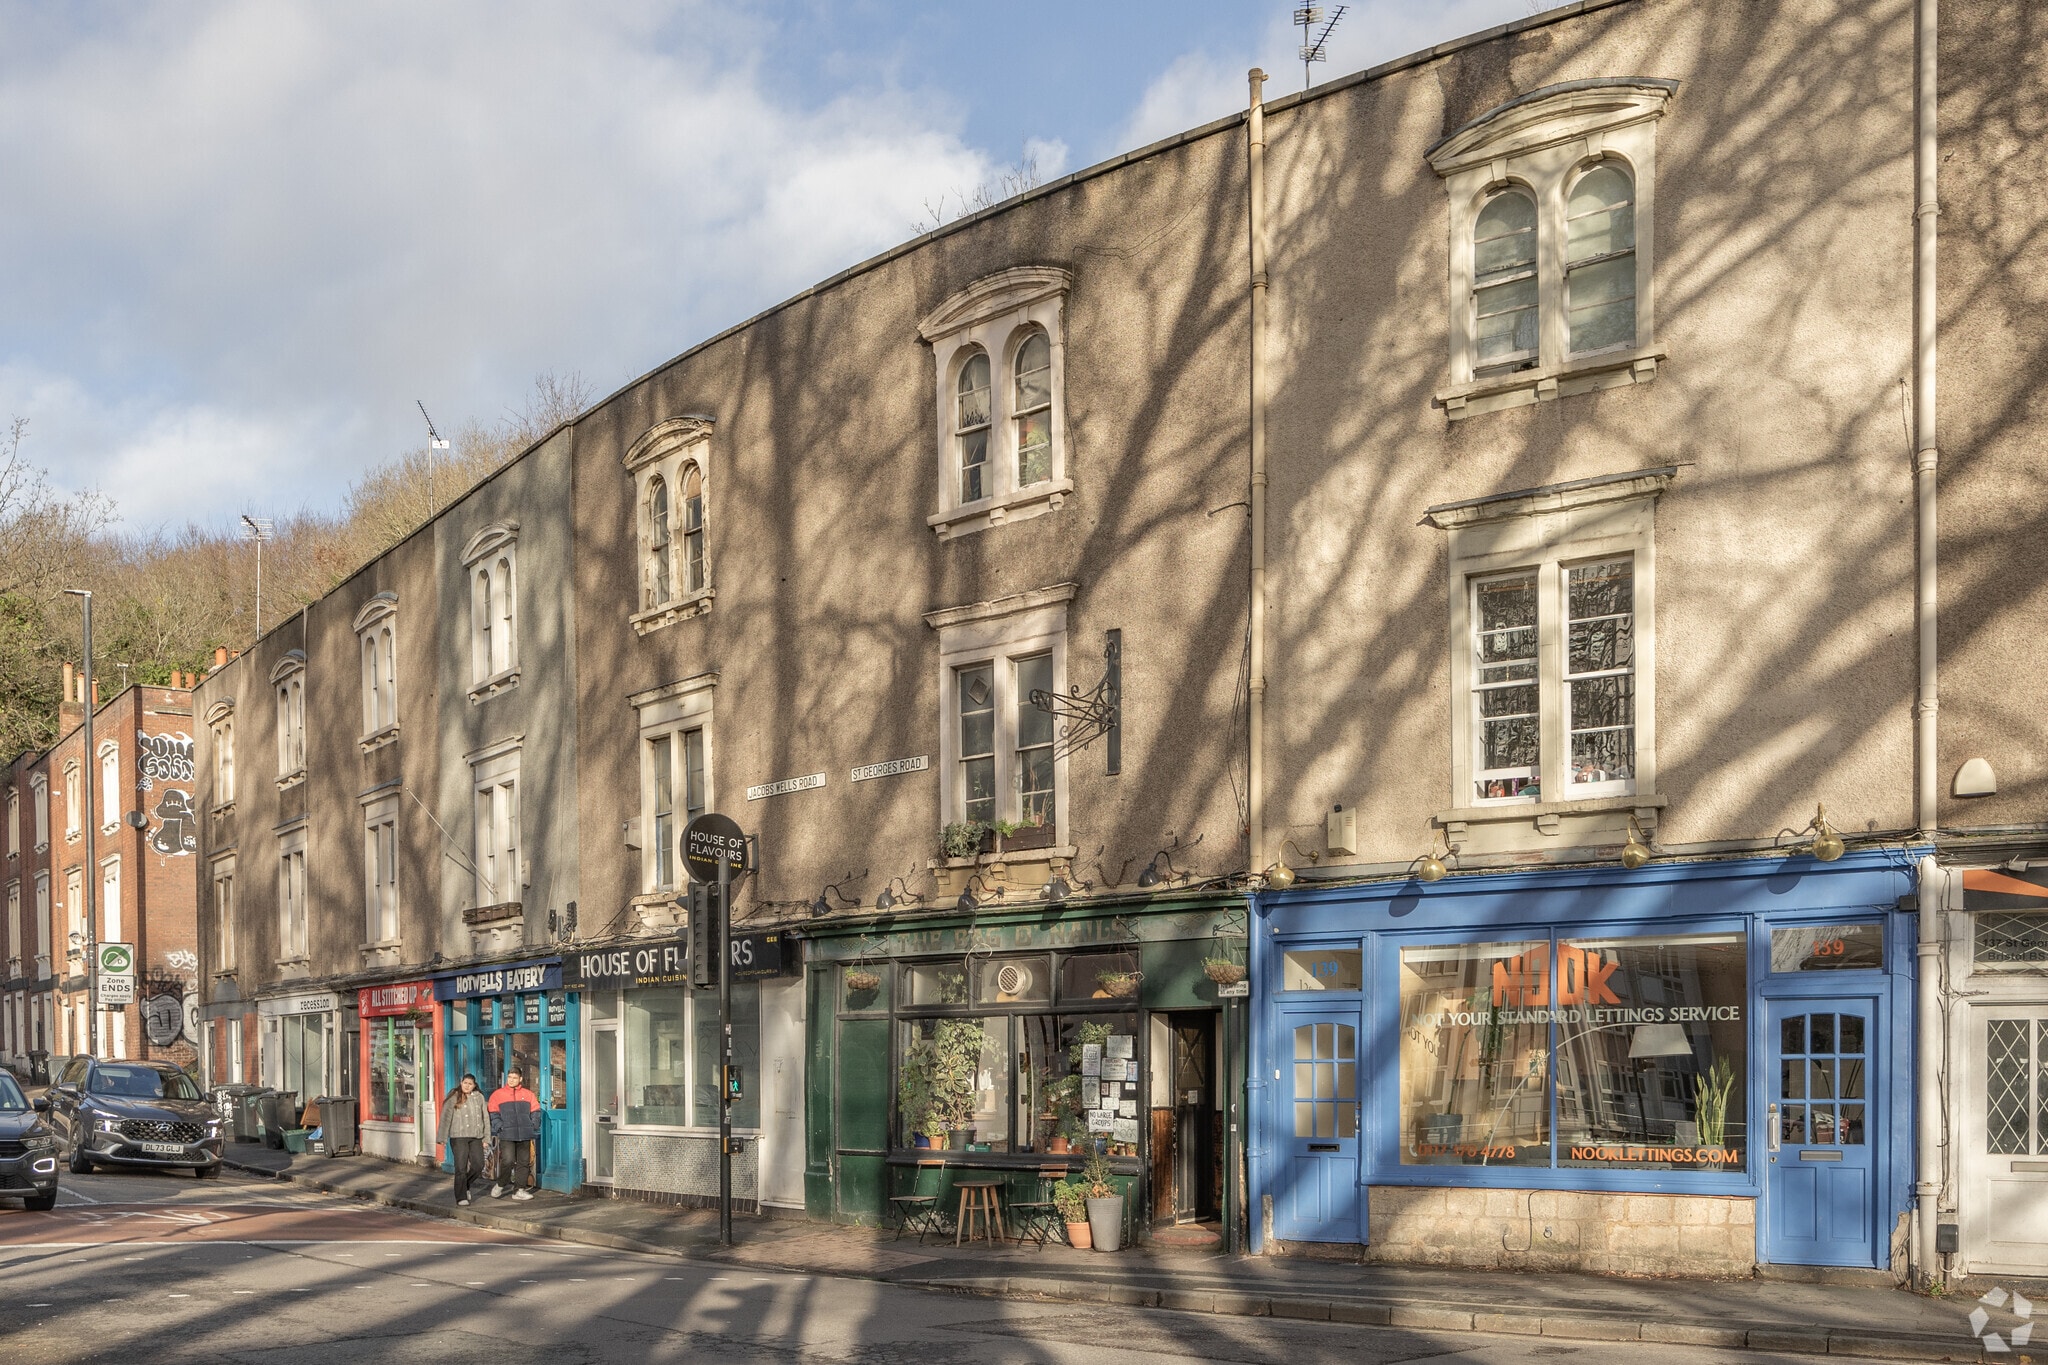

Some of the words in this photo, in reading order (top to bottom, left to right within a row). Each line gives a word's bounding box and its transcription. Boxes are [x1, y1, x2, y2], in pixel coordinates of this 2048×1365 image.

[853, 769, 861, 780] ST
[863, 762, 897, 778] GEORGES
[900, 757, 921, 771] ROAD
[748, 784, 774, 799] JACOBS
[776, 779, 797, 792] WELLS
[799, 775, 818, 788] ROAD
[690, 831, 725, 846] HOUSE
[728, 838, 744, 849] OF
[689, 855, 712, 863] INDIAN
[690, 843, 742, 861] FLAVOURS
[897, 931, 943, 951] THE
[953, 927, 1001, 948] BAG
[1049, 918, 1126, 944] NAILS
[1982, 938, 2002, 948] 137
[2005, 938, 2018, 948] St
[1812, 938, 1846, 957] 139
[1988, 952, 2026, 961] Bristol
[580, 952, 631, 979] HOUSE
[635, 948, 659, 974] OF
[1311, 960, 1339, 978] 139
[456, 971, 503, 993] HOTWELLS
[506, 964, 547, 991] EATERY
[635, 976, 660, 984] INDIAN
[662, 974, 688, 982] CUISIN
[1493, 943, 1621, 1006] NOOK
[101, 984, 131, 992] ENDS
[371, 989, 382, 1007] ALL
[382, 986, 409, 1006] STITCHED
[408, 985, 417, 1004] UP
[300, 998, 330, 1010] recession
[1412, 1013, 1445, 1026] NOT
[1446, 1011, 1493, 1026] YOUR
[1497, 1008, 1582, 1026] STANDARD
[1586, 1006, 1665, 1023] LETTINGS
[1668, 1005, 1741, 1022] SERVICE
[1089, 1111, 1097, 1119] NO
[145, 1143, 165, 1152] DL73
[1480, 1145, 1517, 1160] 4778
[1571, 1146, 1739, 1164] NOOKLETTINGS.COM
